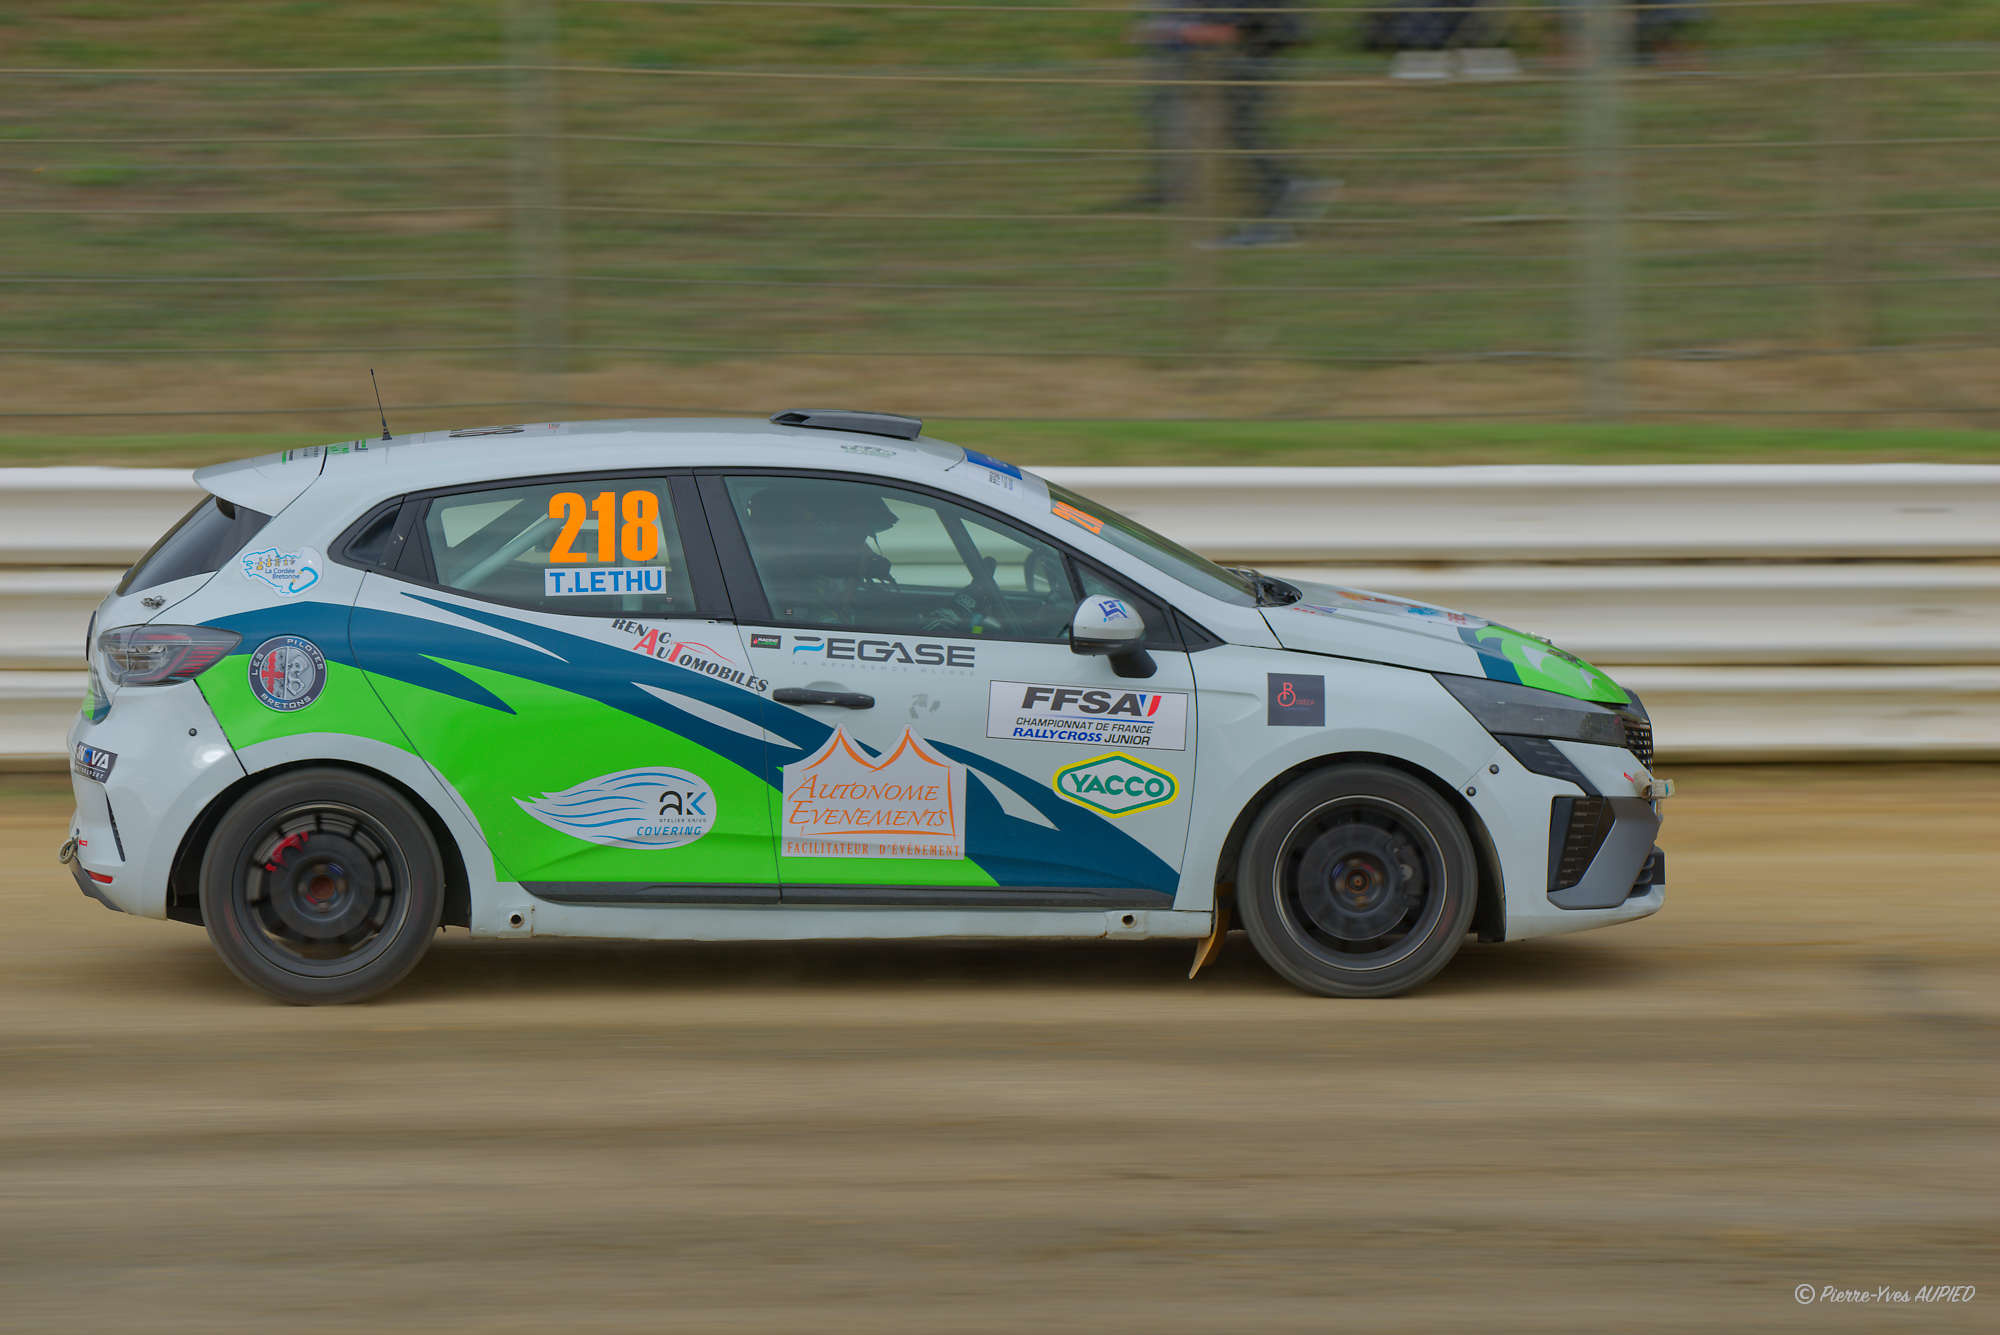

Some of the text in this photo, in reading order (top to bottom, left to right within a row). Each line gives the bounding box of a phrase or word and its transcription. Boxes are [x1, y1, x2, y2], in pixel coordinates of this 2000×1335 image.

[549, 490, 659, 563] 218
[549, 570, 662, 593] T.LETHU
[251, 638, 324, 676] LES PILOTES
[793, 635, 976, 668] PEGASE
[260, 693, 312, 709] BRETONS
[1021, 686, 1143, 717] FFSA
[1016, 716, 1153, 734] CHAMPIONNAT DE FRANCE
[1013, 728, 1151, 746] RALLYCROSS JUNIOR
[788, 774, 940, 803] AUTONOME
[1070, 774, 1165, 798] YACCO
[636, 826, 704, 836] COVERING
[787, 841, 869, 856] FACILITATEUR
